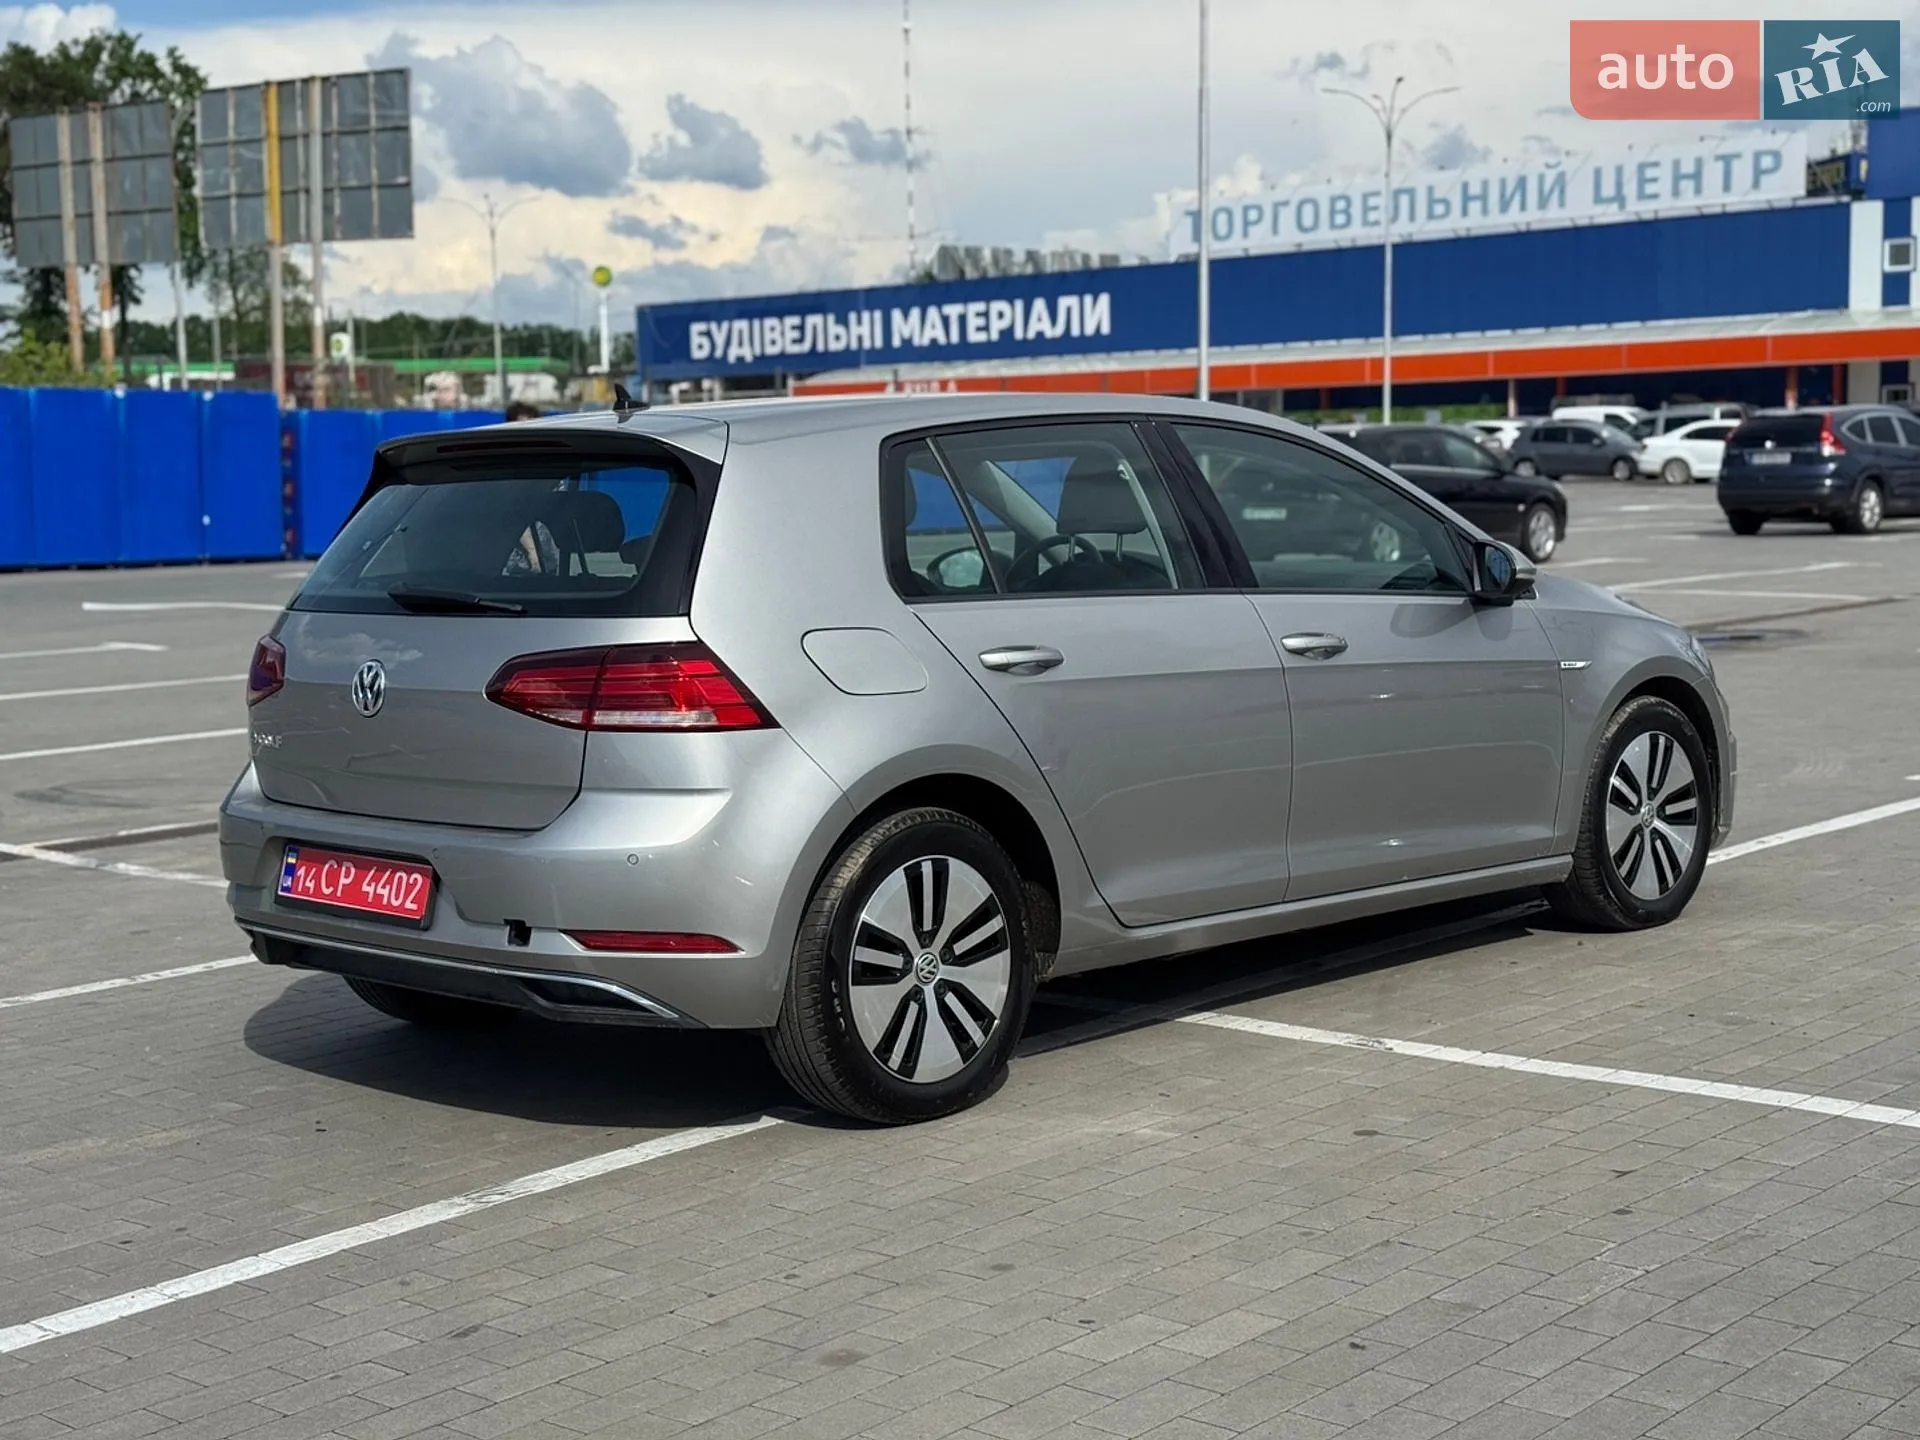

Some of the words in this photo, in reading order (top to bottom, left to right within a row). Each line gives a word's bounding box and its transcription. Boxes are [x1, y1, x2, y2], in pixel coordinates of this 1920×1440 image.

[1593, 148, 1784, 212] ЦЕНТР
[689, 308, 884, 364] БУДІВЕЛЬНІ
[890, 292, 1112, 348] МАТЕРІАЛИ
[362, 865, 423, 911] 4402
